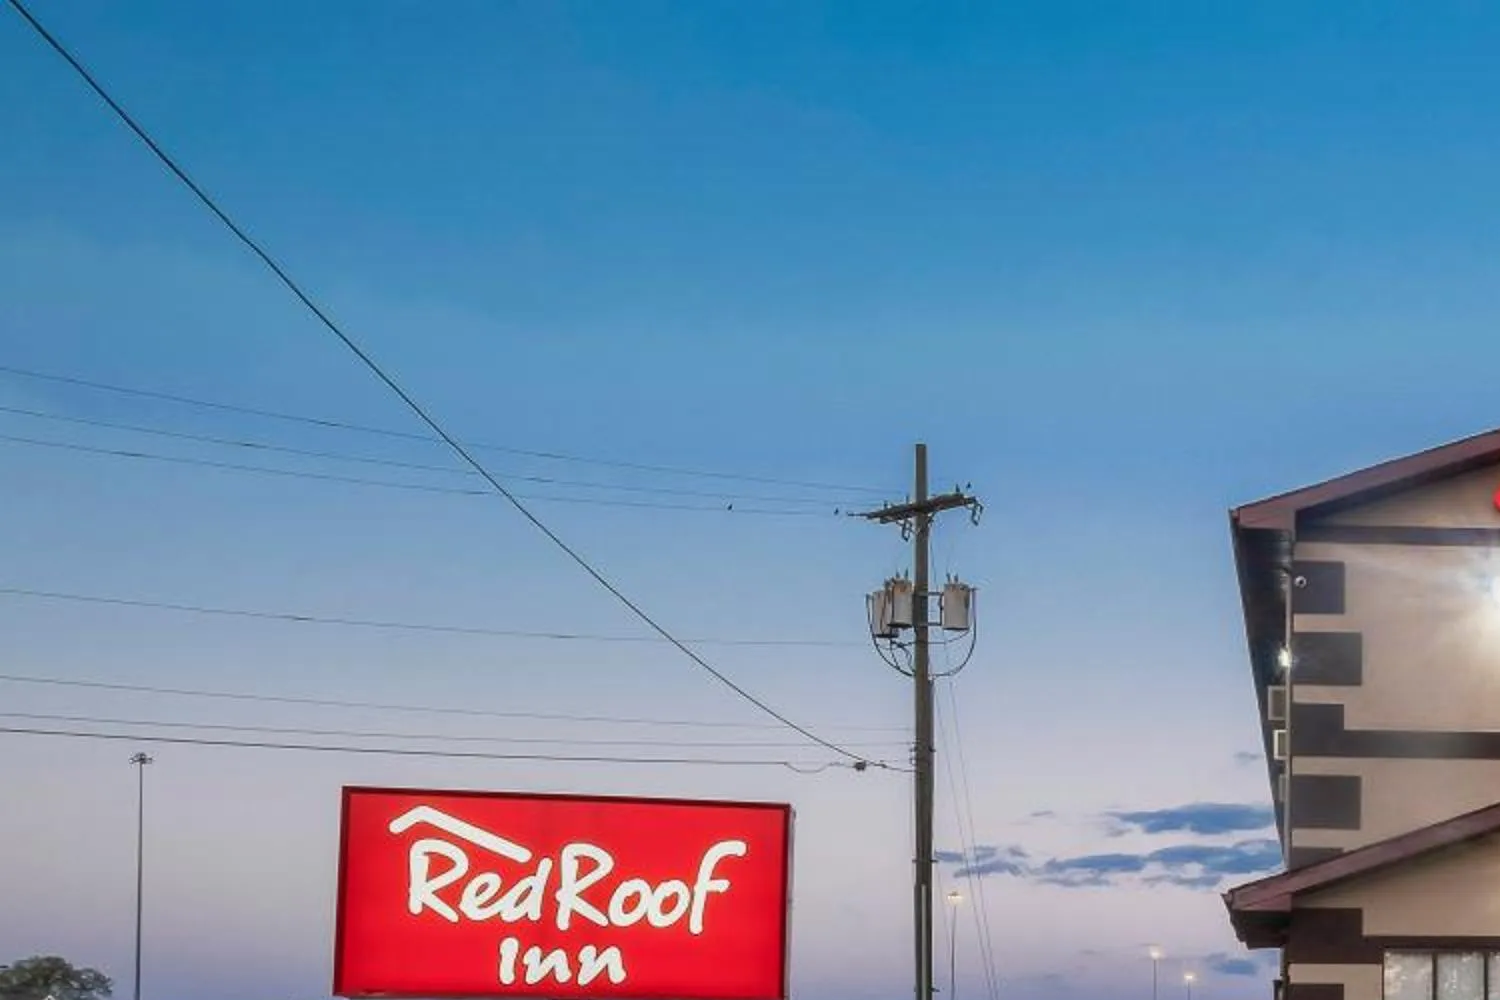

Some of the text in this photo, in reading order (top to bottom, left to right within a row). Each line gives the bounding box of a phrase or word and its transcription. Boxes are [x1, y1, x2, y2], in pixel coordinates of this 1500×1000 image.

[408, 838, 747, 935] Red Roof
[498, 937, 627, 985] Inn
